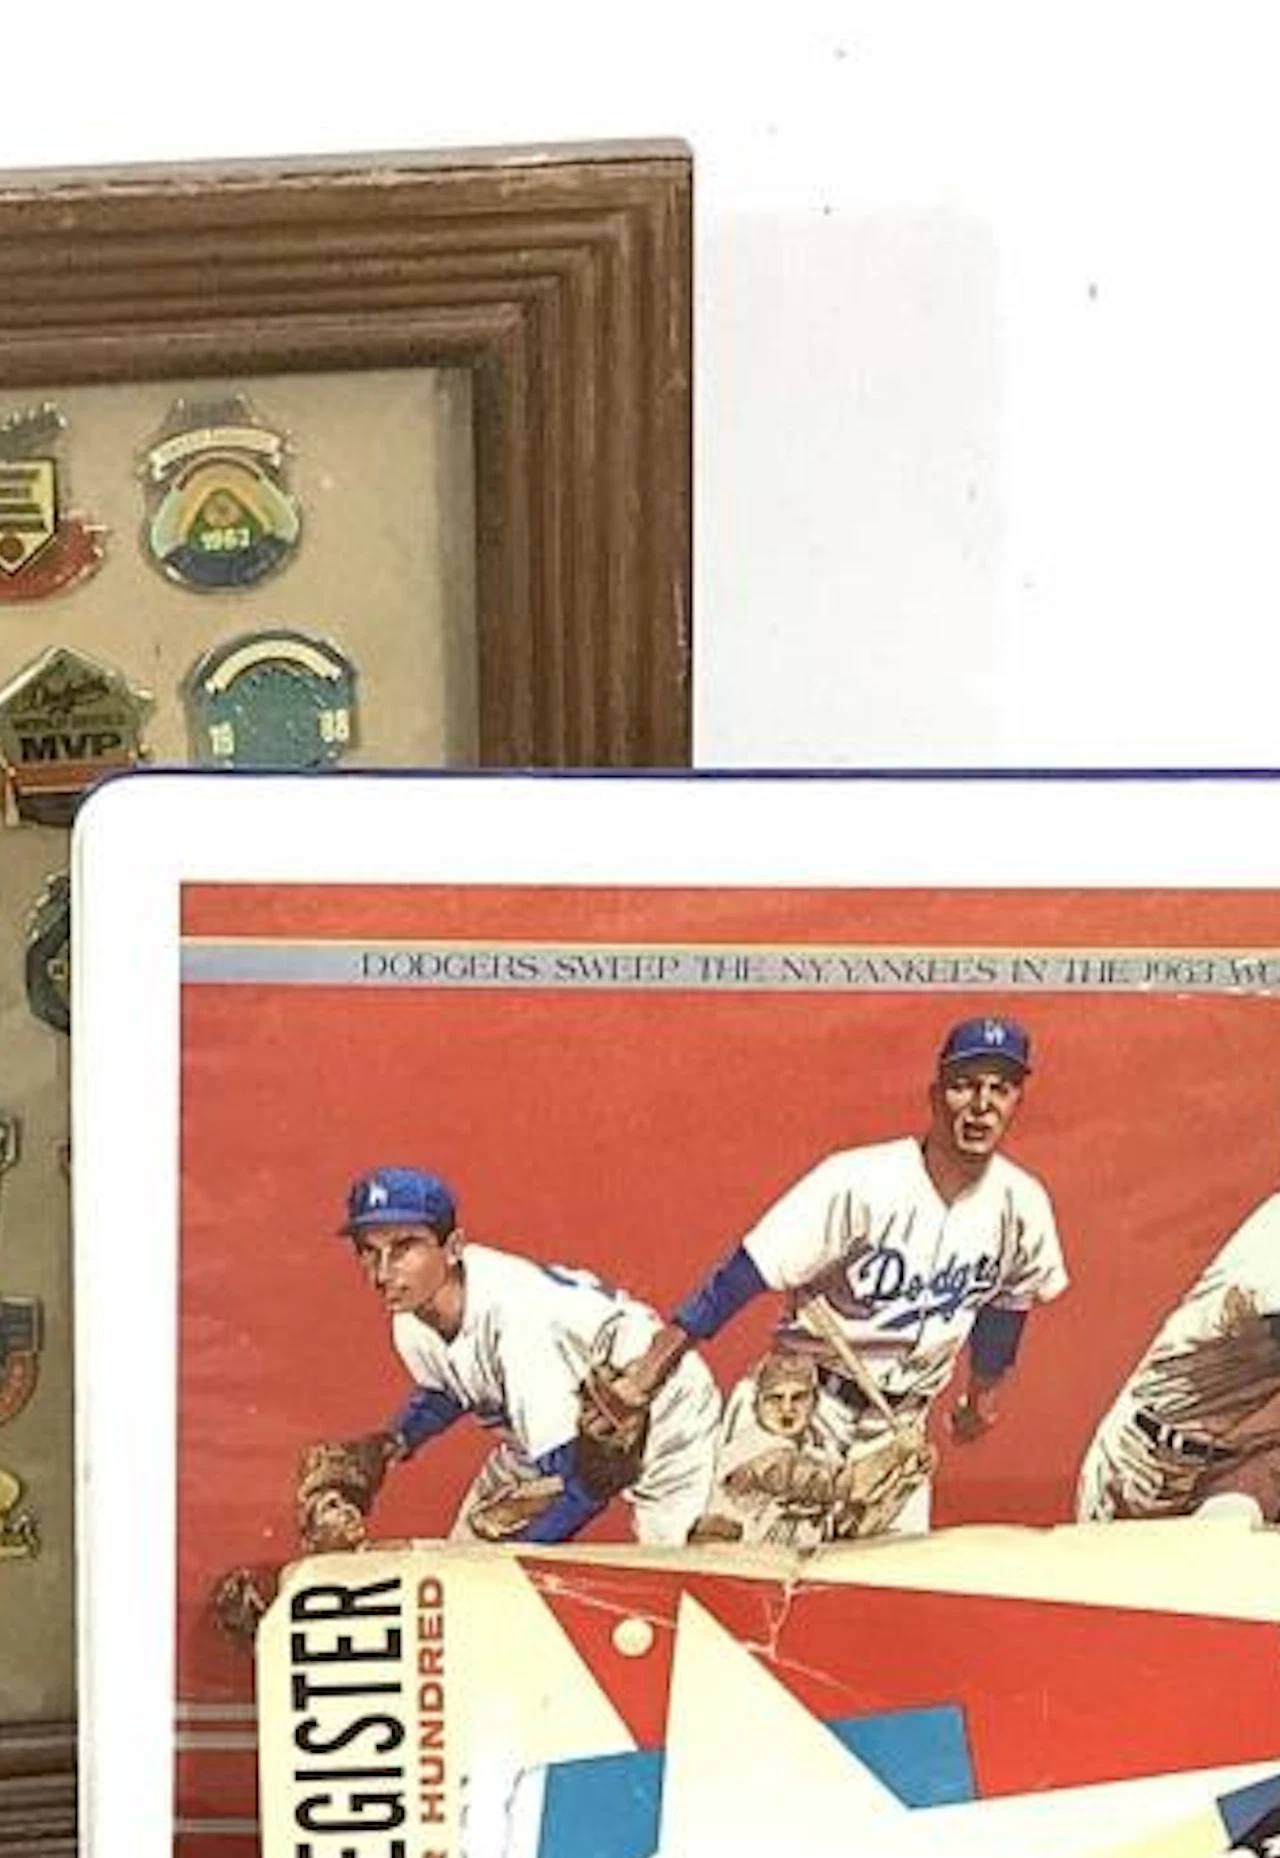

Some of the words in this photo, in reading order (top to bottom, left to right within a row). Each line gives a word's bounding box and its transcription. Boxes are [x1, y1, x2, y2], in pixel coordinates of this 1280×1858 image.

[21, 733, 122, 761] MVP
[360, 951, 538, 982] DODGERS
[554, 954, 681, 982] SWEEP
[695, 956, 764, 983] THE
[838, 956, 997, 985] YANKEES
[1011, 957, 1048, 984] IN
[1062, 957, 1132, 984] THE
[1140, 957, 1216, 985] 1963
[417, 1578, 445, 1824] HUNDRED
